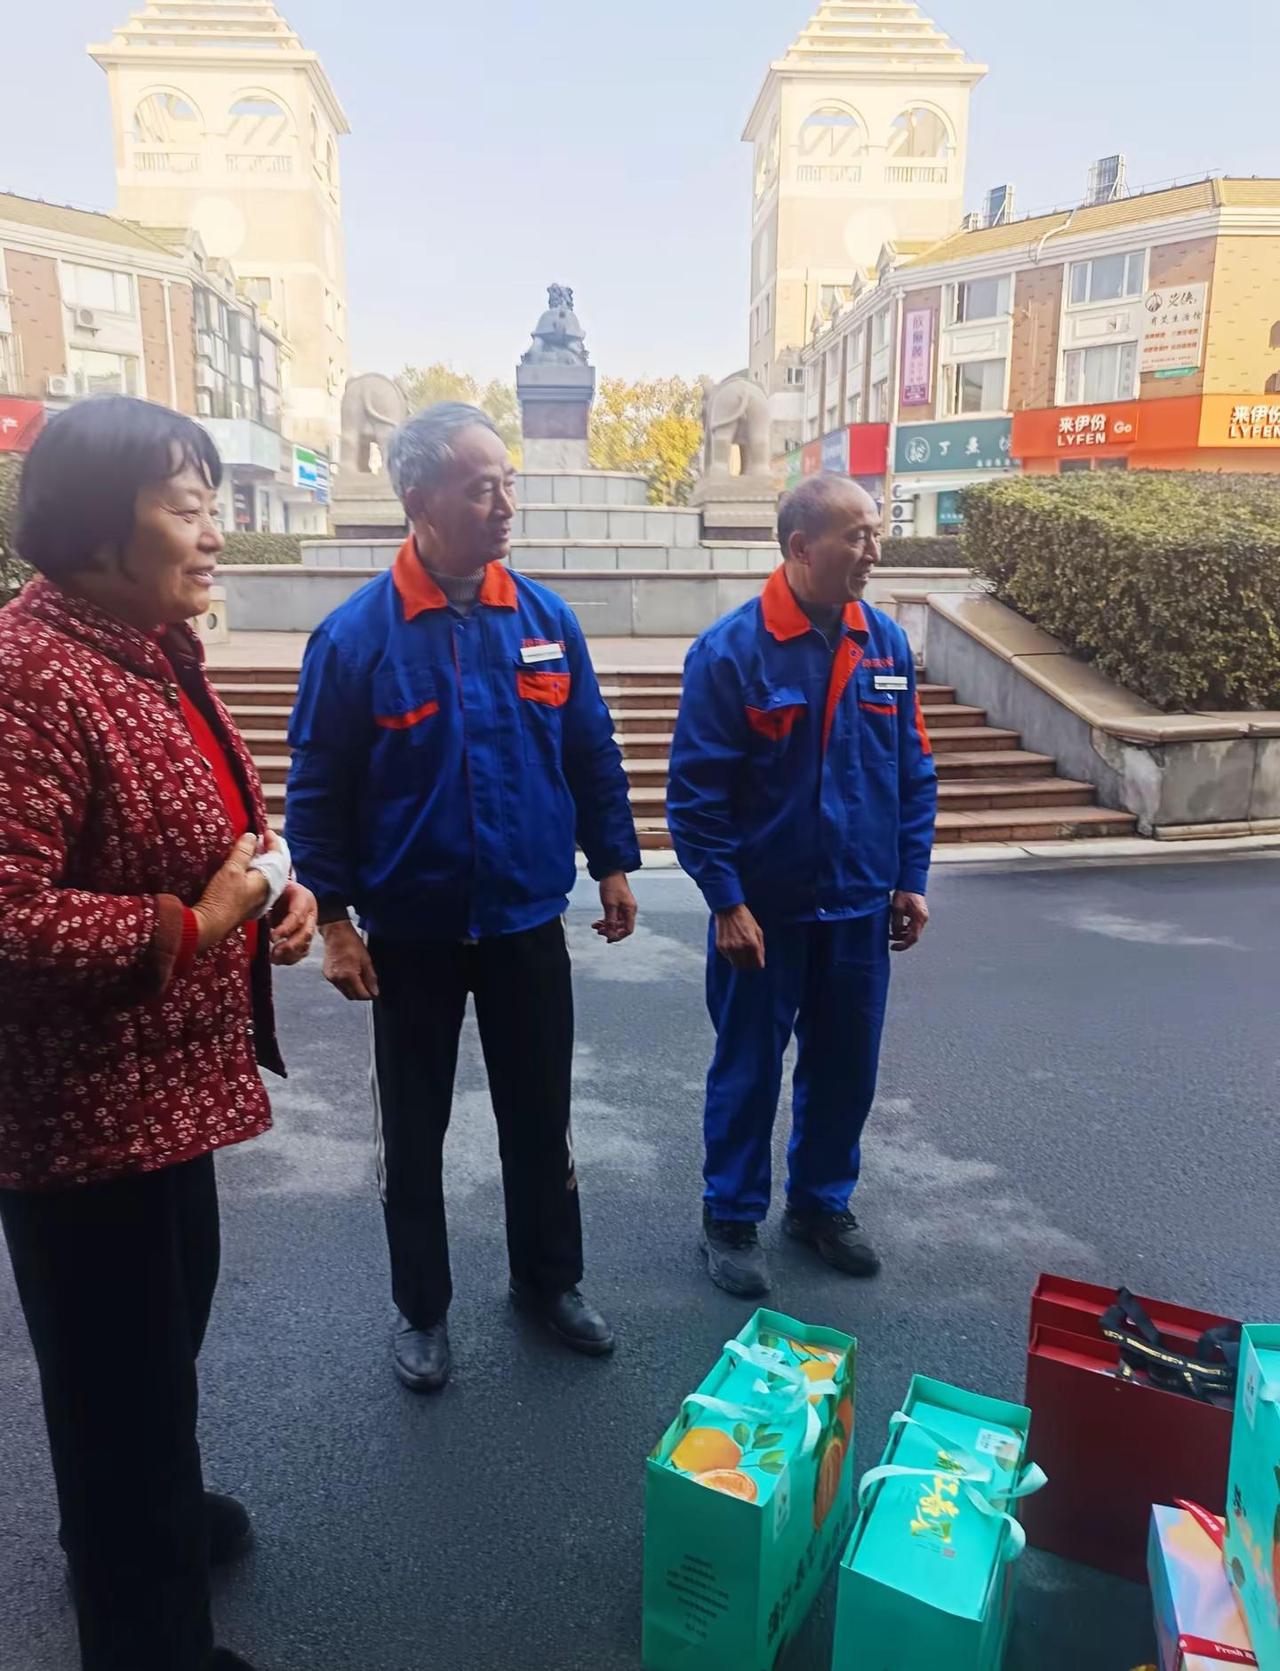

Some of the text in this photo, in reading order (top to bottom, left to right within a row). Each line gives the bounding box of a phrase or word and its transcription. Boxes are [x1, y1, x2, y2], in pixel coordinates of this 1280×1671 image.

[1231, 405, 1280, 425] 来伊份
[1059, 413, 1106, 433] 来伊份
[1113, 420, 1132, 433] Go
[1229, 425, 1280, 438] LYFEN
[1057, 432, 1106, 447] LYFEN
